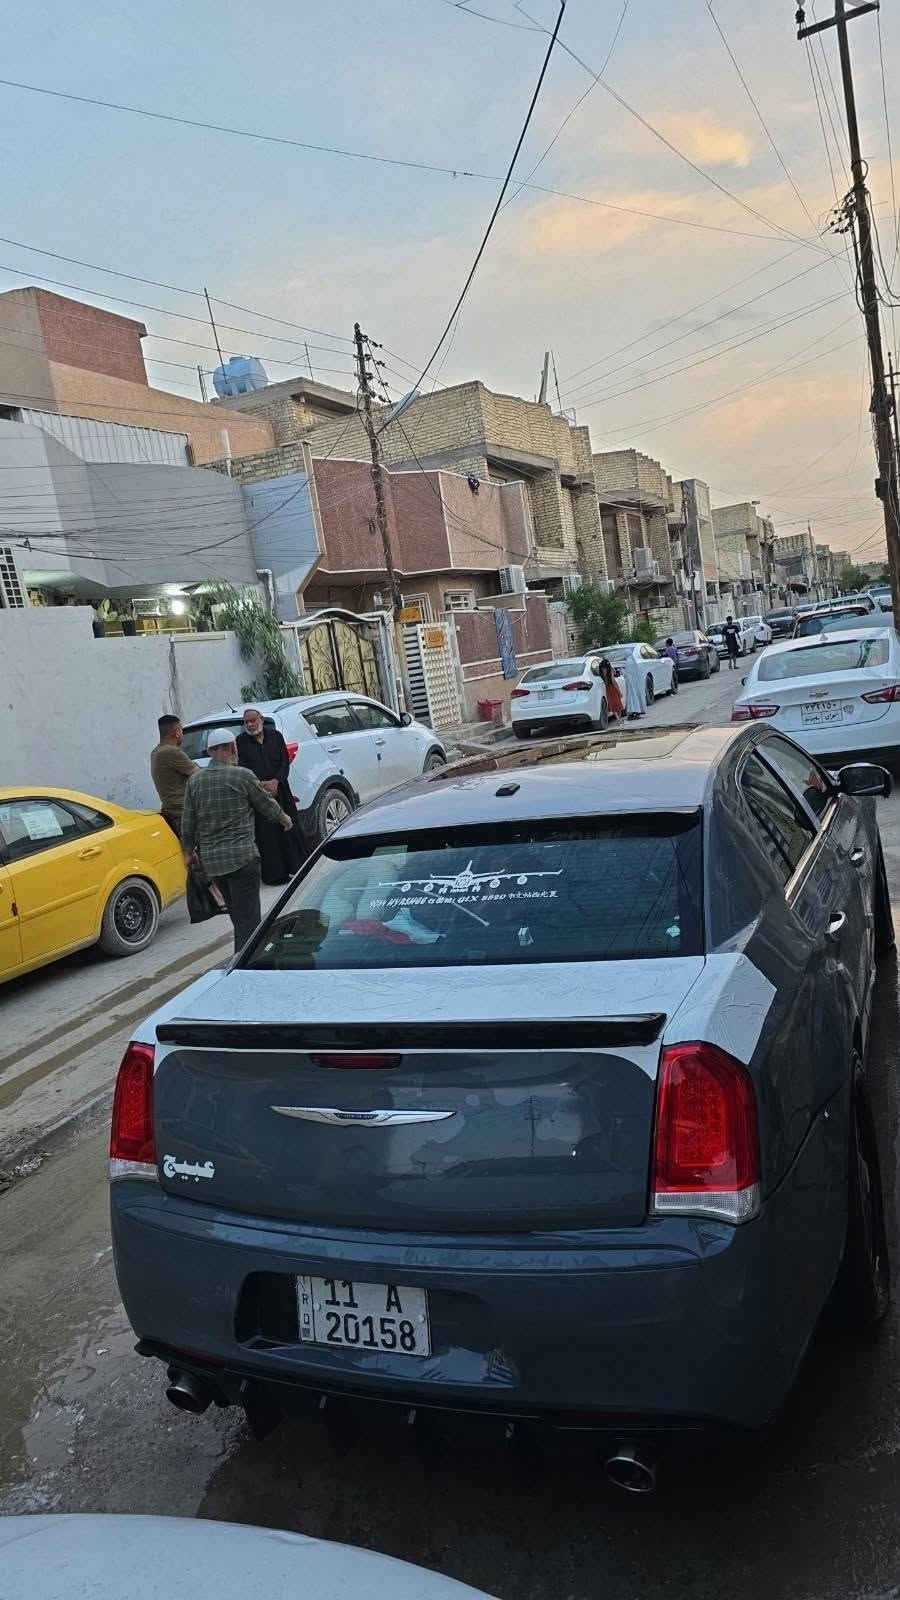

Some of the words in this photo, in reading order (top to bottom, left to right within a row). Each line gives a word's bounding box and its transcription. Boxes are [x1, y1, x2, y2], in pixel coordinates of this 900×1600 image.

[324, 1279, 359, 1309] 11
[386, 1284, 403, 1314] A
[325, 1311, 417, 1352] 20158
